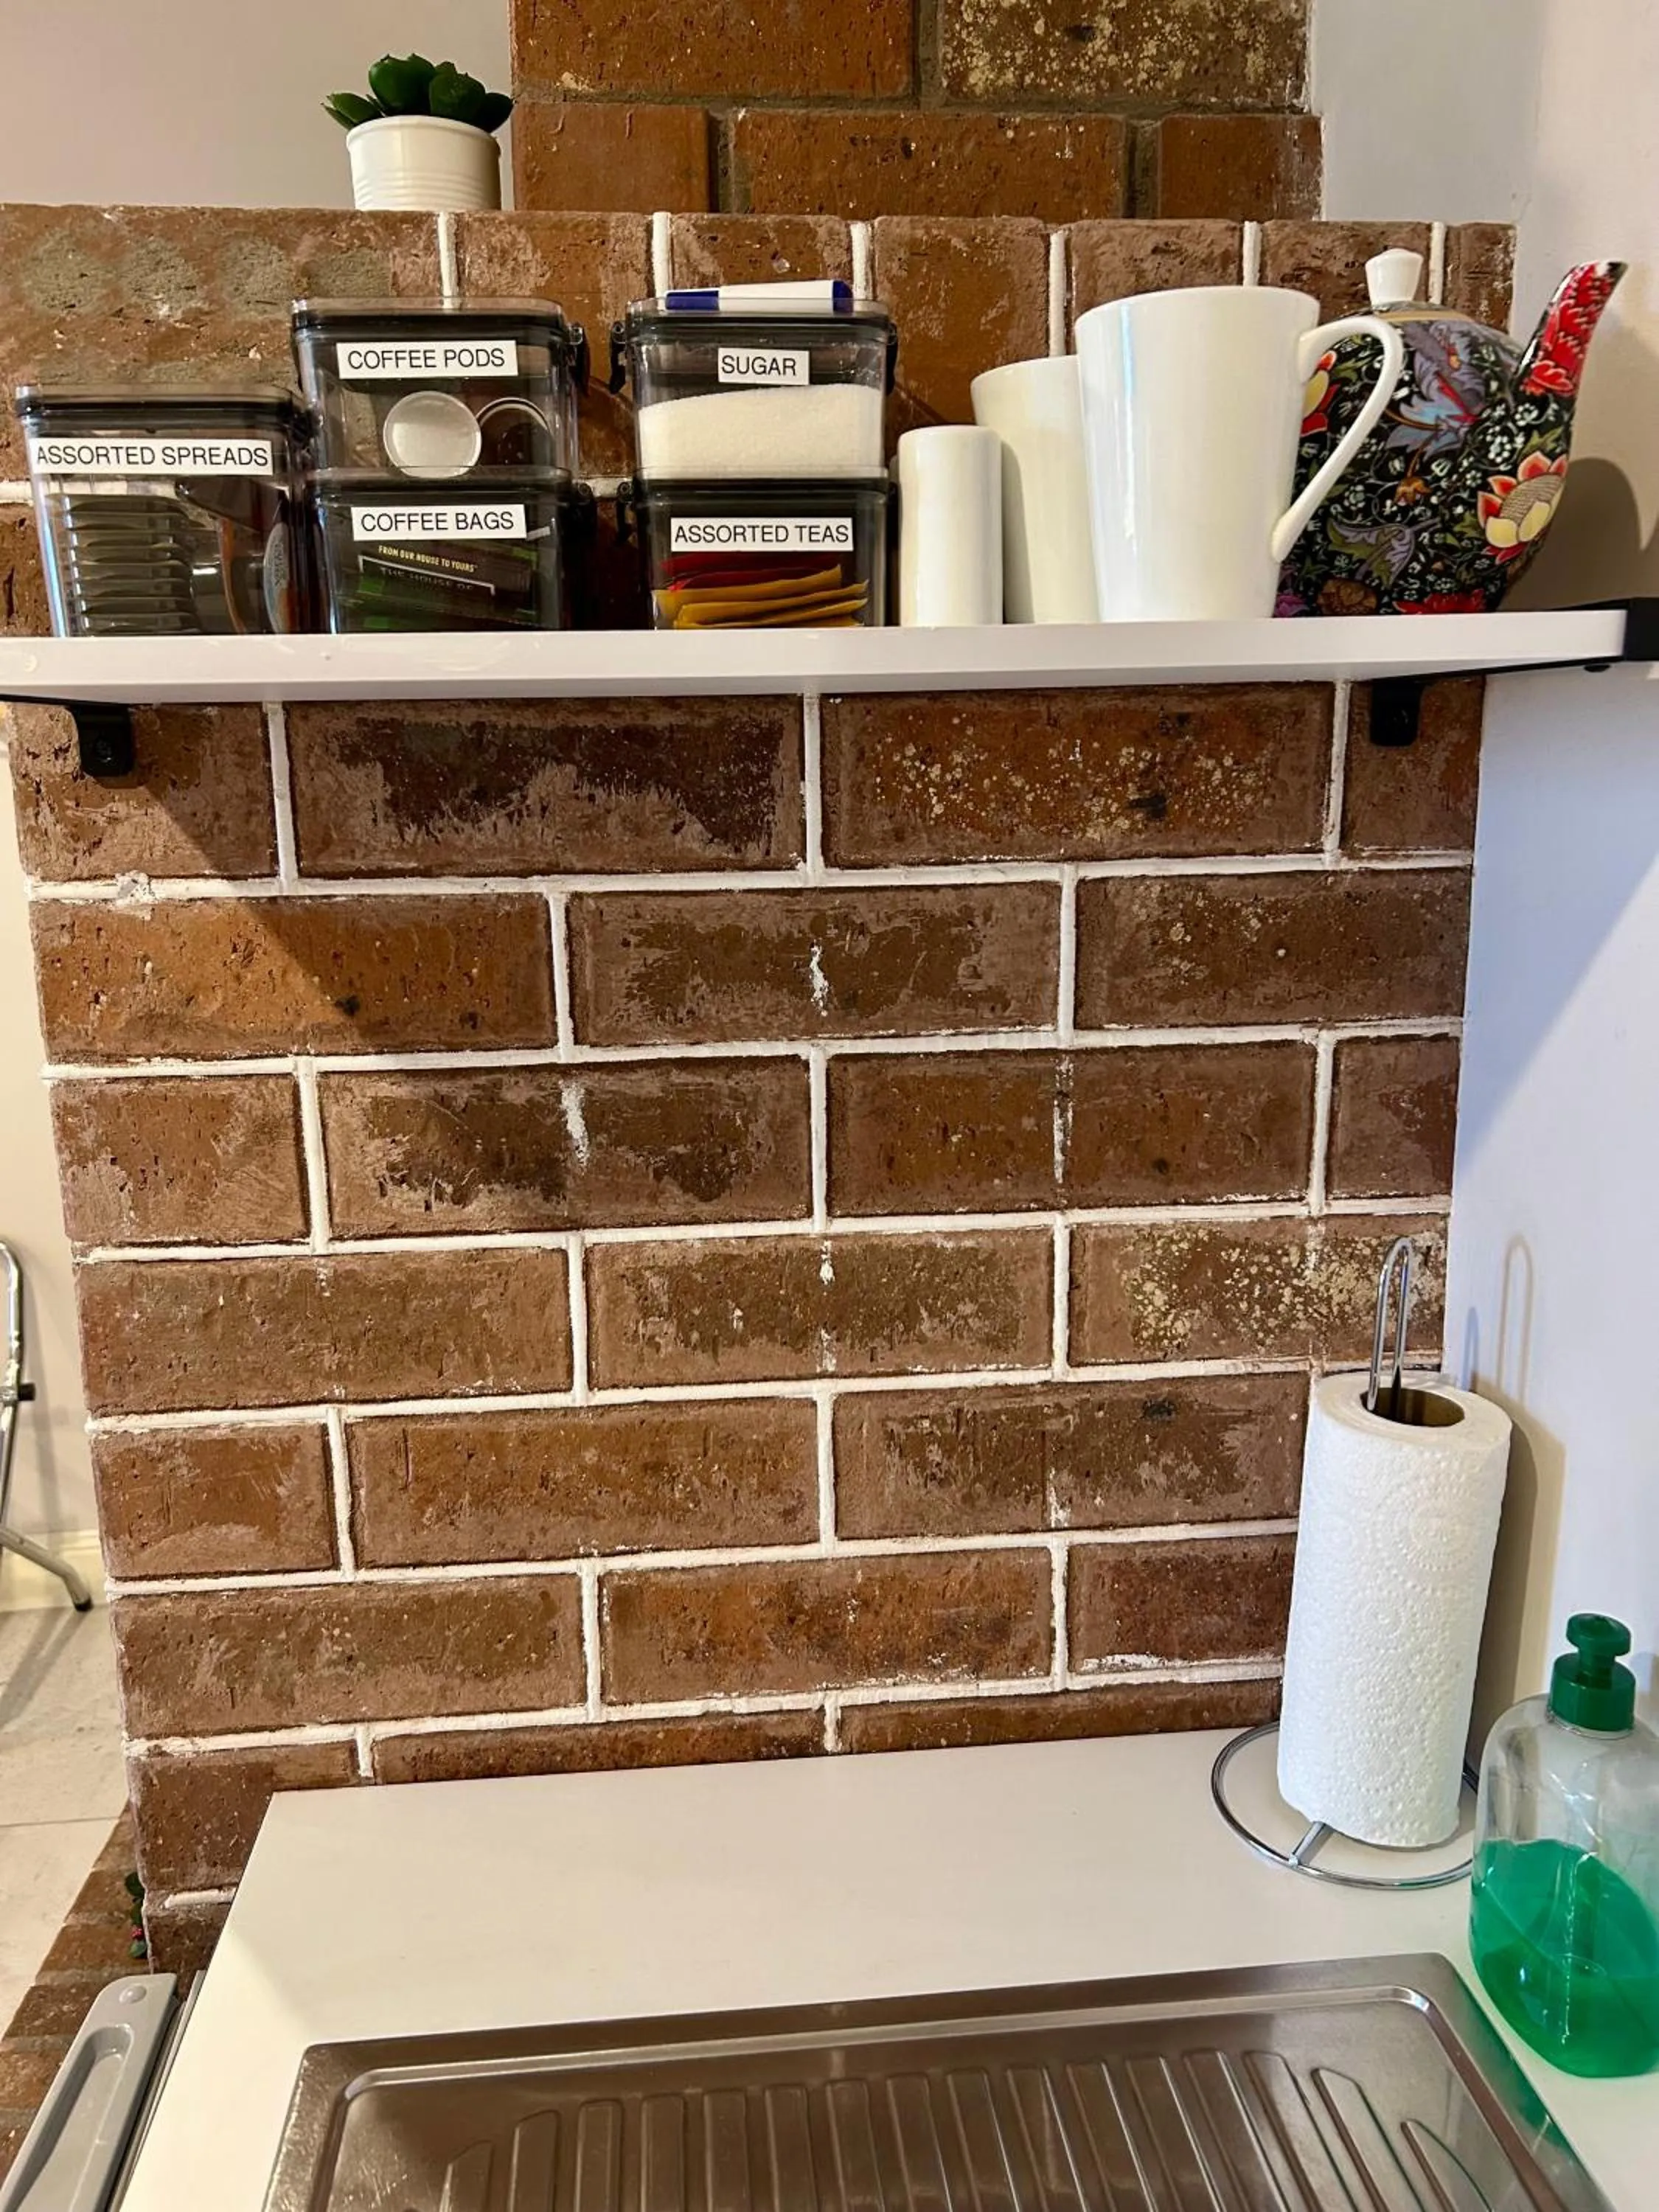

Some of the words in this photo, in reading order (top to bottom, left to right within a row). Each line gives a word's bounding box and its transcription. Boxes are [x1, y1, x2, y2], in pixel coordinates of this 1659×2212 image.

[348, 349, 437, 369] COFFEE
[444, 348, 505, 368] PODS
[722, 355, 796, 376] SUGAR
[38, 445, 156, 465] ASSORTED
[161, 447, 268, 467] SPREADS
[361, 512, 448, 532] COFFEE
[455, 511, 514, 530] BAGS
[675, 524, 789, 543] ASSORTED
[794, 524, 849, 543] TEAS
[378, 545, 399, 557] FROM
[399, 549, 415, 560] OUR
[415, 554, 440, 566] HOUSE
[441, 558, 450, 568] TO
